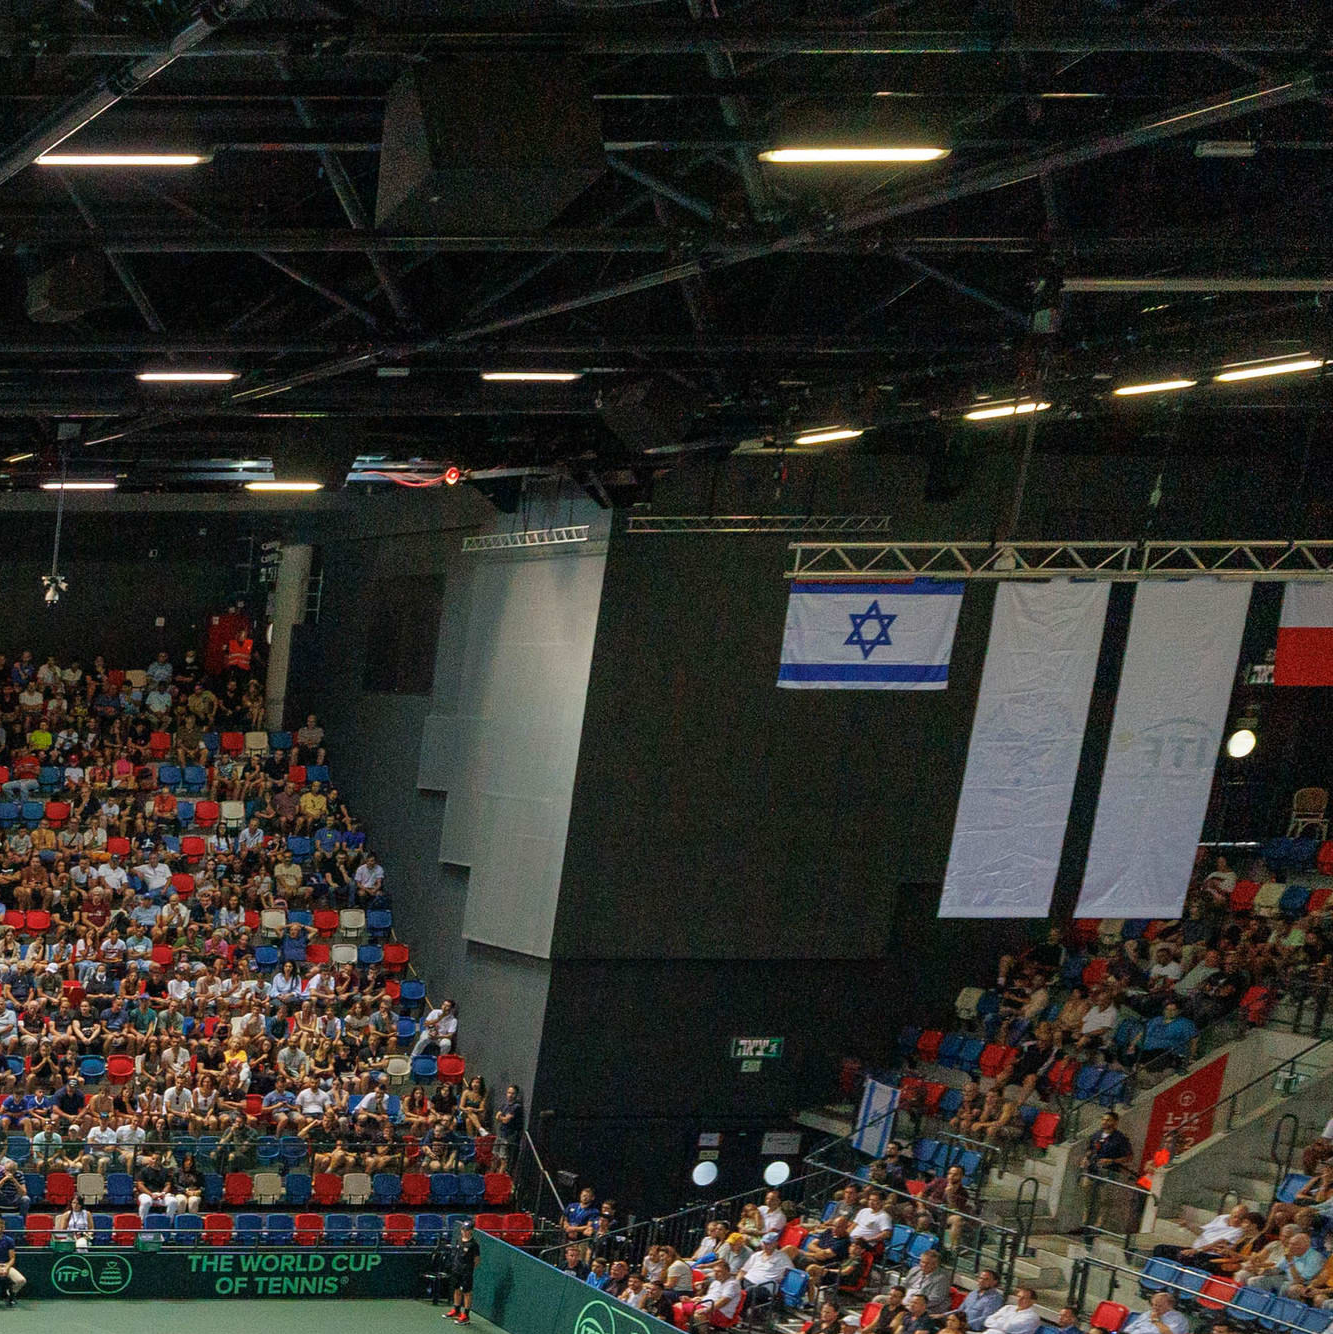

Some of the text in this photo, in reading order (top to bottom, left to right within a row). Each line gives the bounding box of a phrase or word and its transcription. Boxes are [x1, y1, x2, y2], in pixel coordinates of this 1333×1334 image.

[188, 1255, 381, 1272] THE WORLD CUP
[57, 1270, 80, 1282] ITF
[215, 1277, 247, 1295] OF
